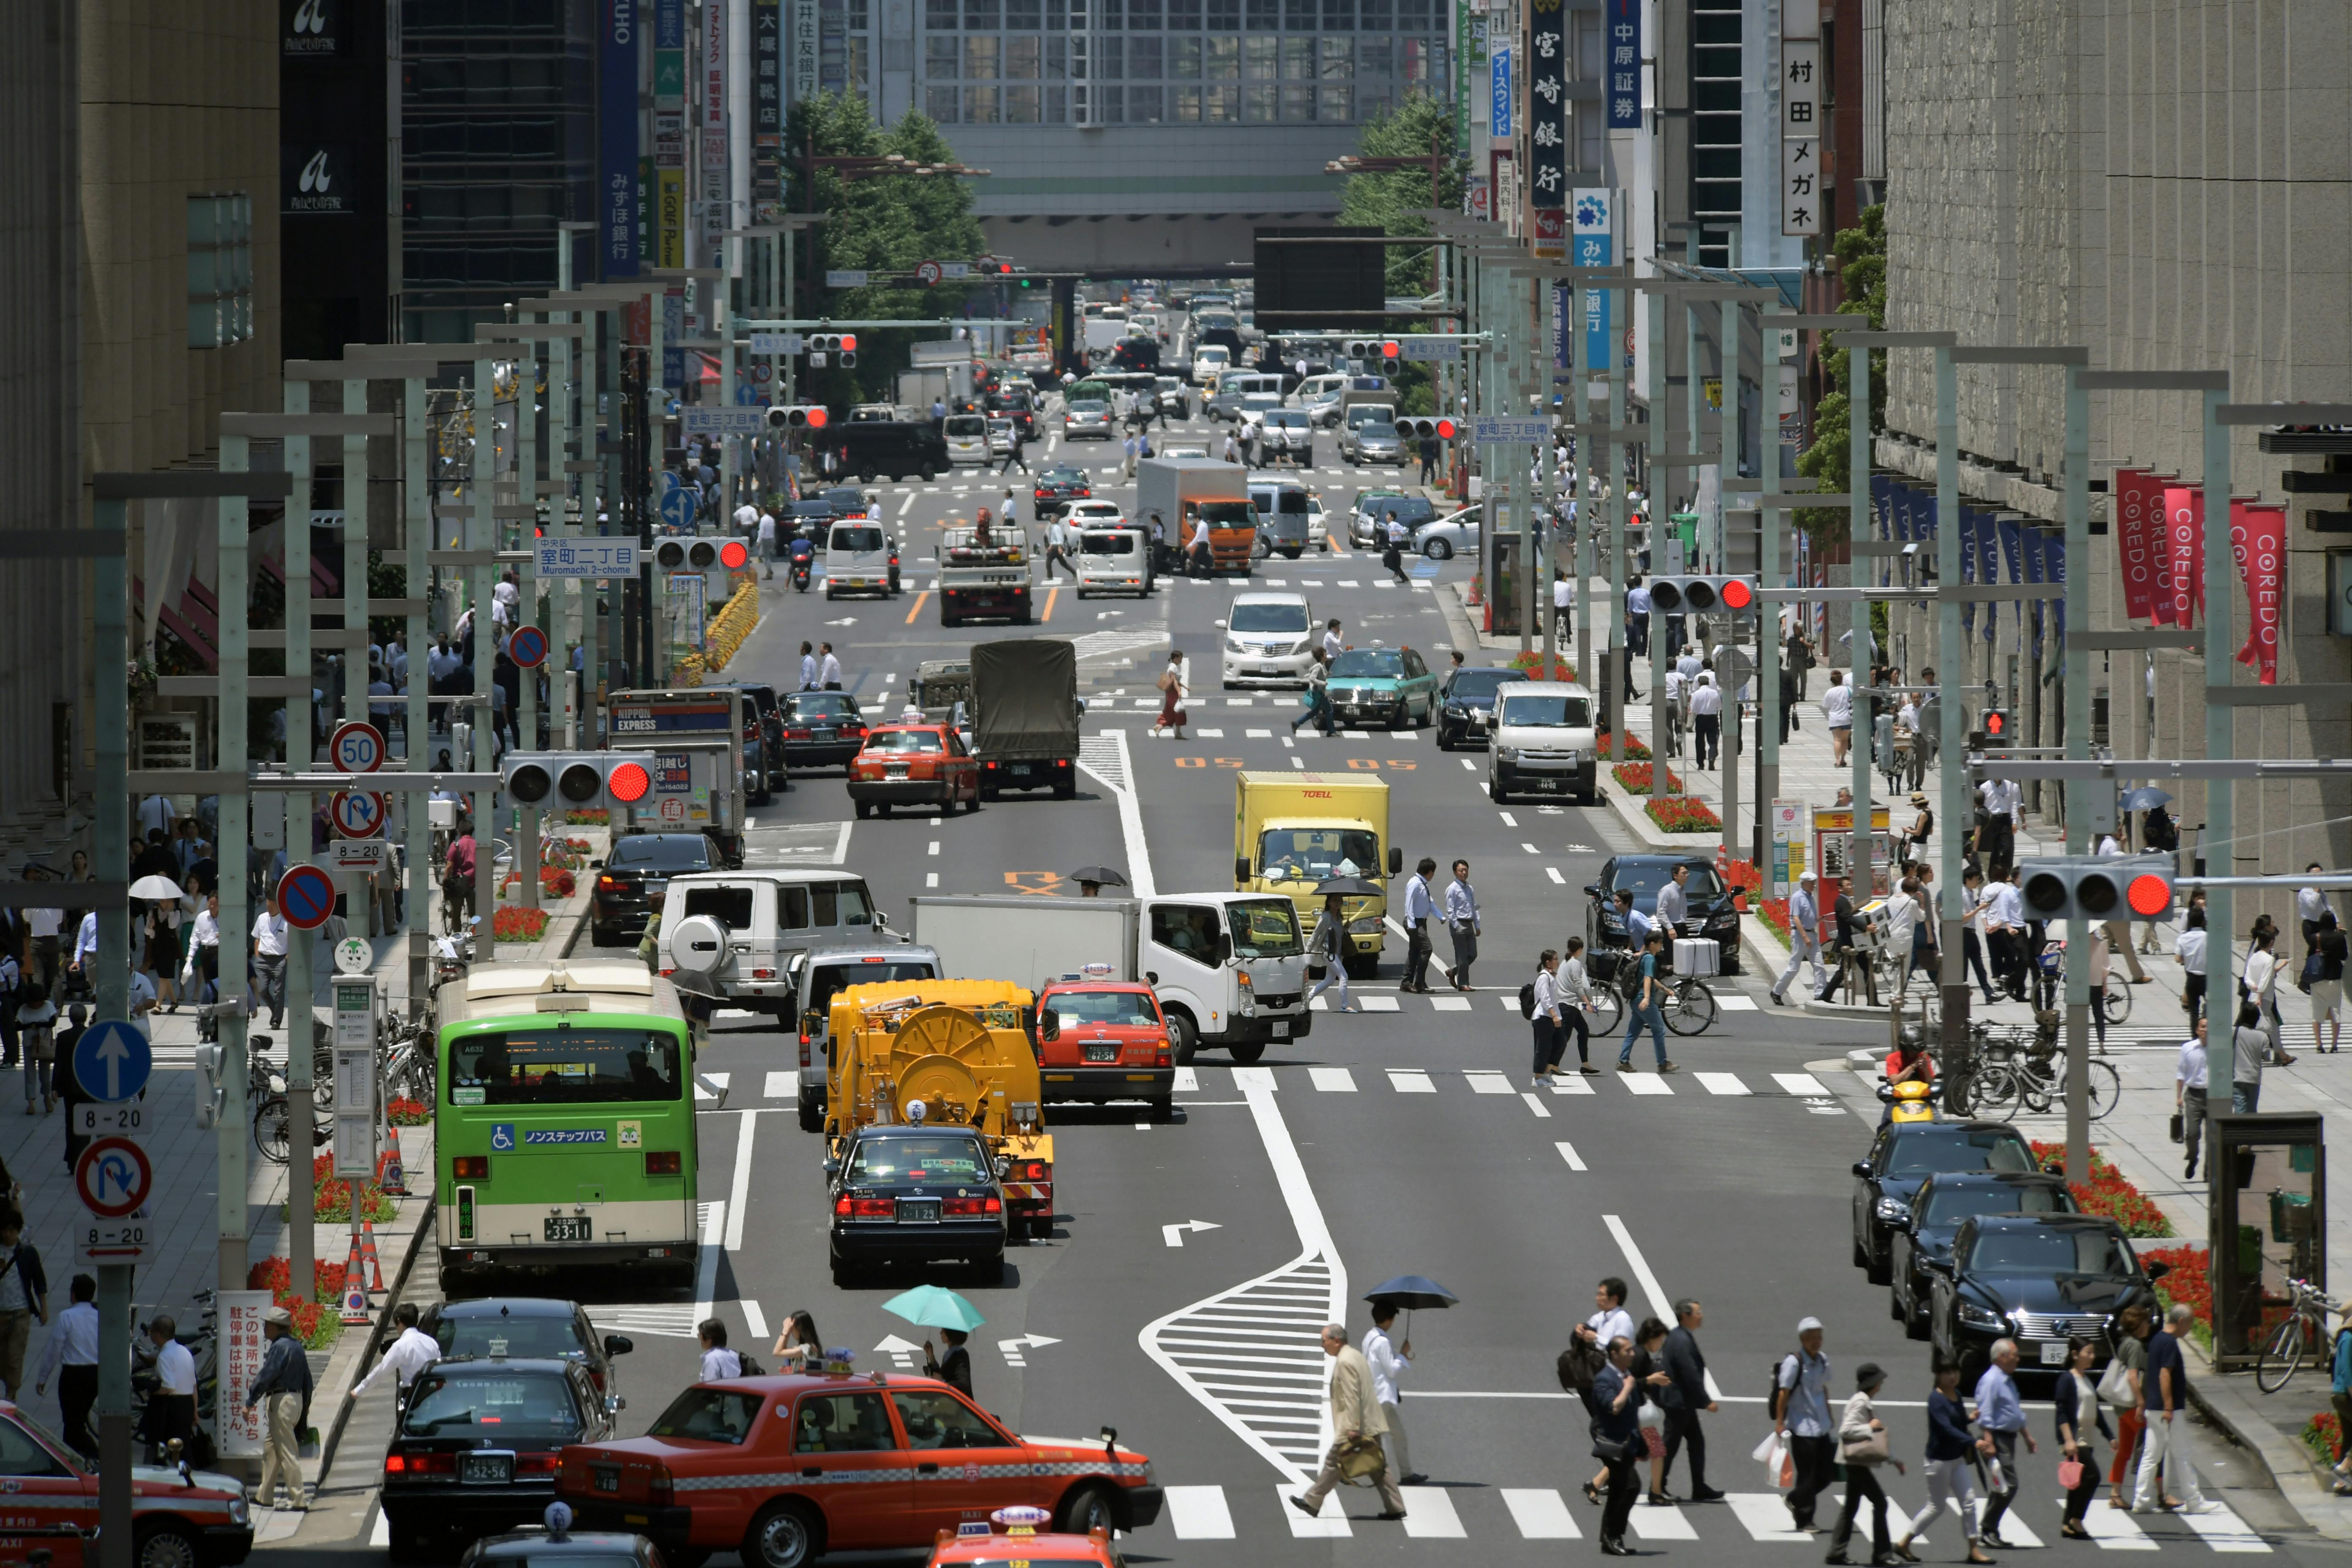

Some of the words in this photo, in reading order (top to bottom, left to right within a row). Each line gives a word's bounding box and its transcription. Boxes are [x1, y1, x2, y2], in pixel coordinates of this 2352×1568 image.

[798, 0, 814, 94] 井住友銀行
[759, 14, 776, 123] 大塚屋靴店
[1614, 23, 1634, 118] 中原証券
[709, 71, 721, 122] 証明写真
[1495, 56, 1508, 135] アースウィンド
[1535, 31, 1563, 193] 宮崎銀行
[1789, 60, 1813, 227] 村田メガネ
[291, 197, 341, 210] 青山きもの学院
[664, 195, 676, 226] GOLF
[612, 174, 628, 259] みずほ銀行
[664, 229, 675, 267] Partner
[922, 267, 936, 278] 50
[1583, 240, 1601, 332] み銀行
[1408, 344, 1456, 353] 室町3丁目
[688, 413, 760, 424] 室町三丁目南
[1477, 424, 1547, 435] 室町三丁目南
[540, 539, 567, 547] 中央区
[2125, 490, 2148, 583] COREDO
[2150, 495, 2171, 589] COREDO
[541, 548, 631, 565] 室町二丁目
[2175, 508, 2192, 611] COREDO
[542, 565, 588, 574] Muromachi
[592, 565, 630, 574] 2-chome
[2257, 534, 2276, 645] COREDO
[618, 709, 651, 719] NIPPON
[618, 719, 656, 730] EXPRESS
[343, 739, 372, 763] 50
[656, 757, 687, 769] 引越し
[656, 770, 688, 781] は日通
[664, 800, 682, 819] 通
[390, 1057, 404, 1072] YAMAHA
[1091, 1051, 1114, 1060] 67-58
[912, 1102, 921, 1118] 大和
[526, 1131, 606, 1143] ノンステップバス
[460, 1202, 472, 1238] 乗降中
[553, 1225, 588, 1239] 33-11
[230, 1306, 242, 1437] 駐停車は出来ません。
[473, 1465, 506, 1478] 52-56
[553, 1507, 564, 1527] 大和
